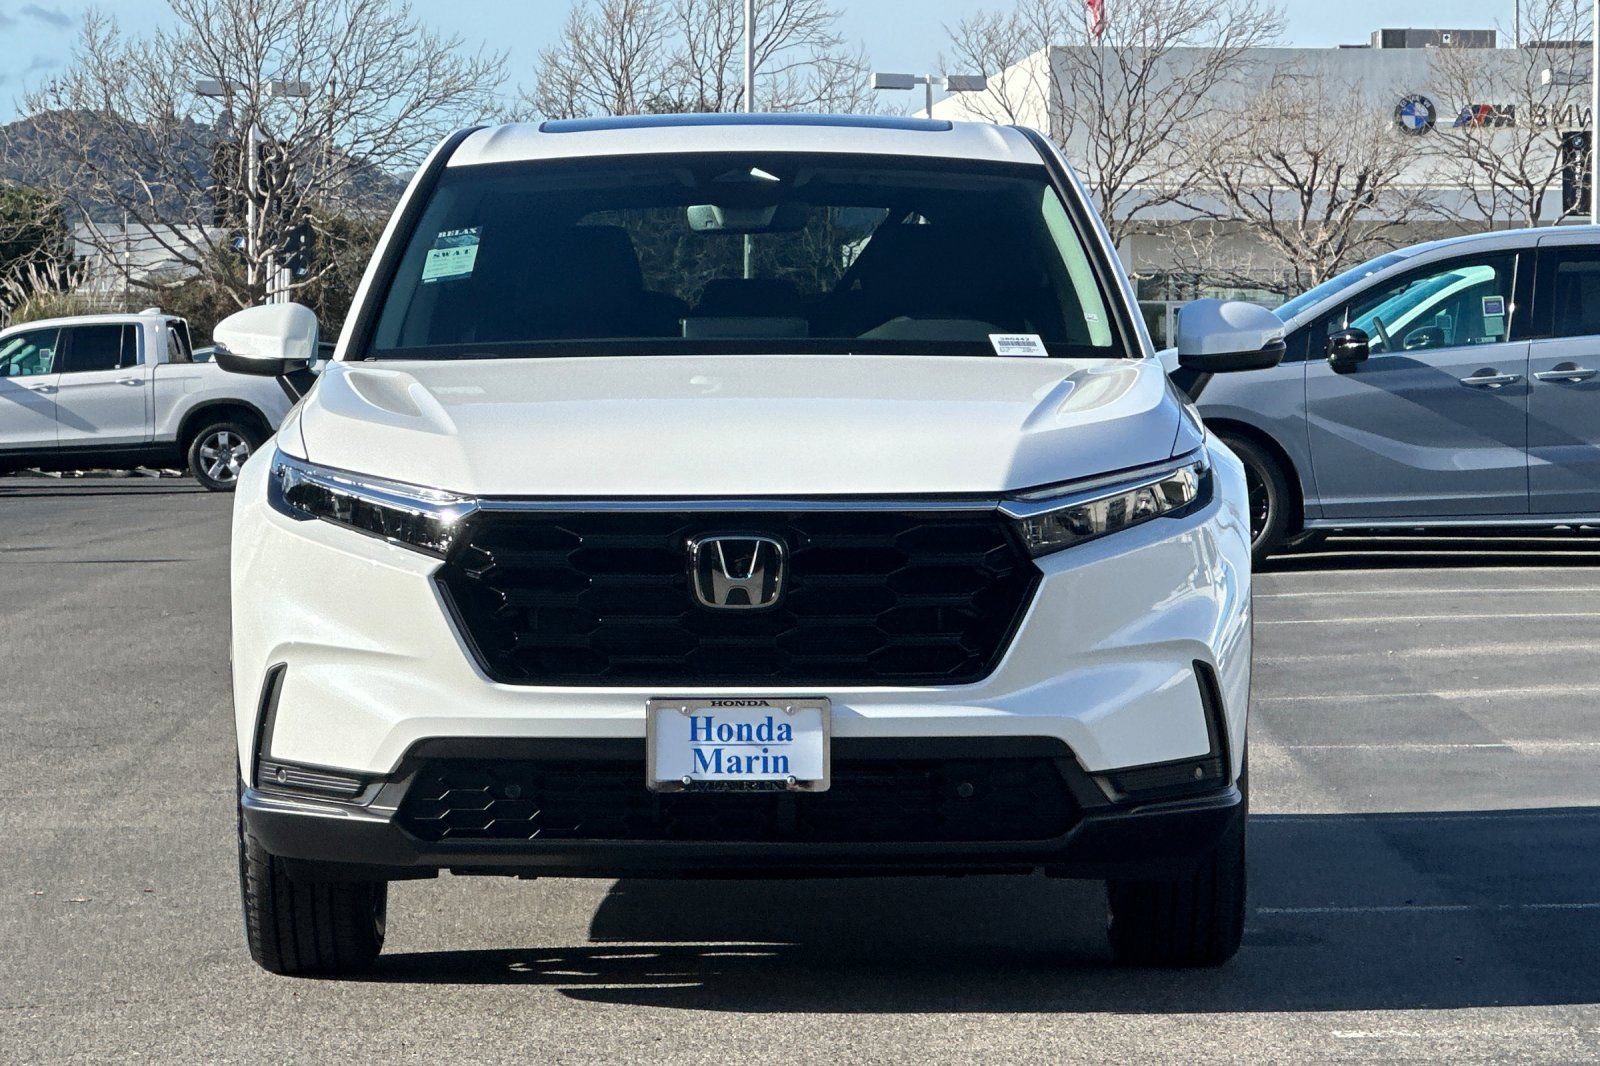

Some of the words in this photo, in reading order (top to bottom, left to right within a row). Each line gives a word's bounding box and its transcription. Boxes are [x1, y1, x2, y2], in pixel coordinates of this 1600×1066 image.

[689, 716, 793, 742] Honda
[691, 748, 790, 774] Marin
[690, 780, 785, 791] MARIN
